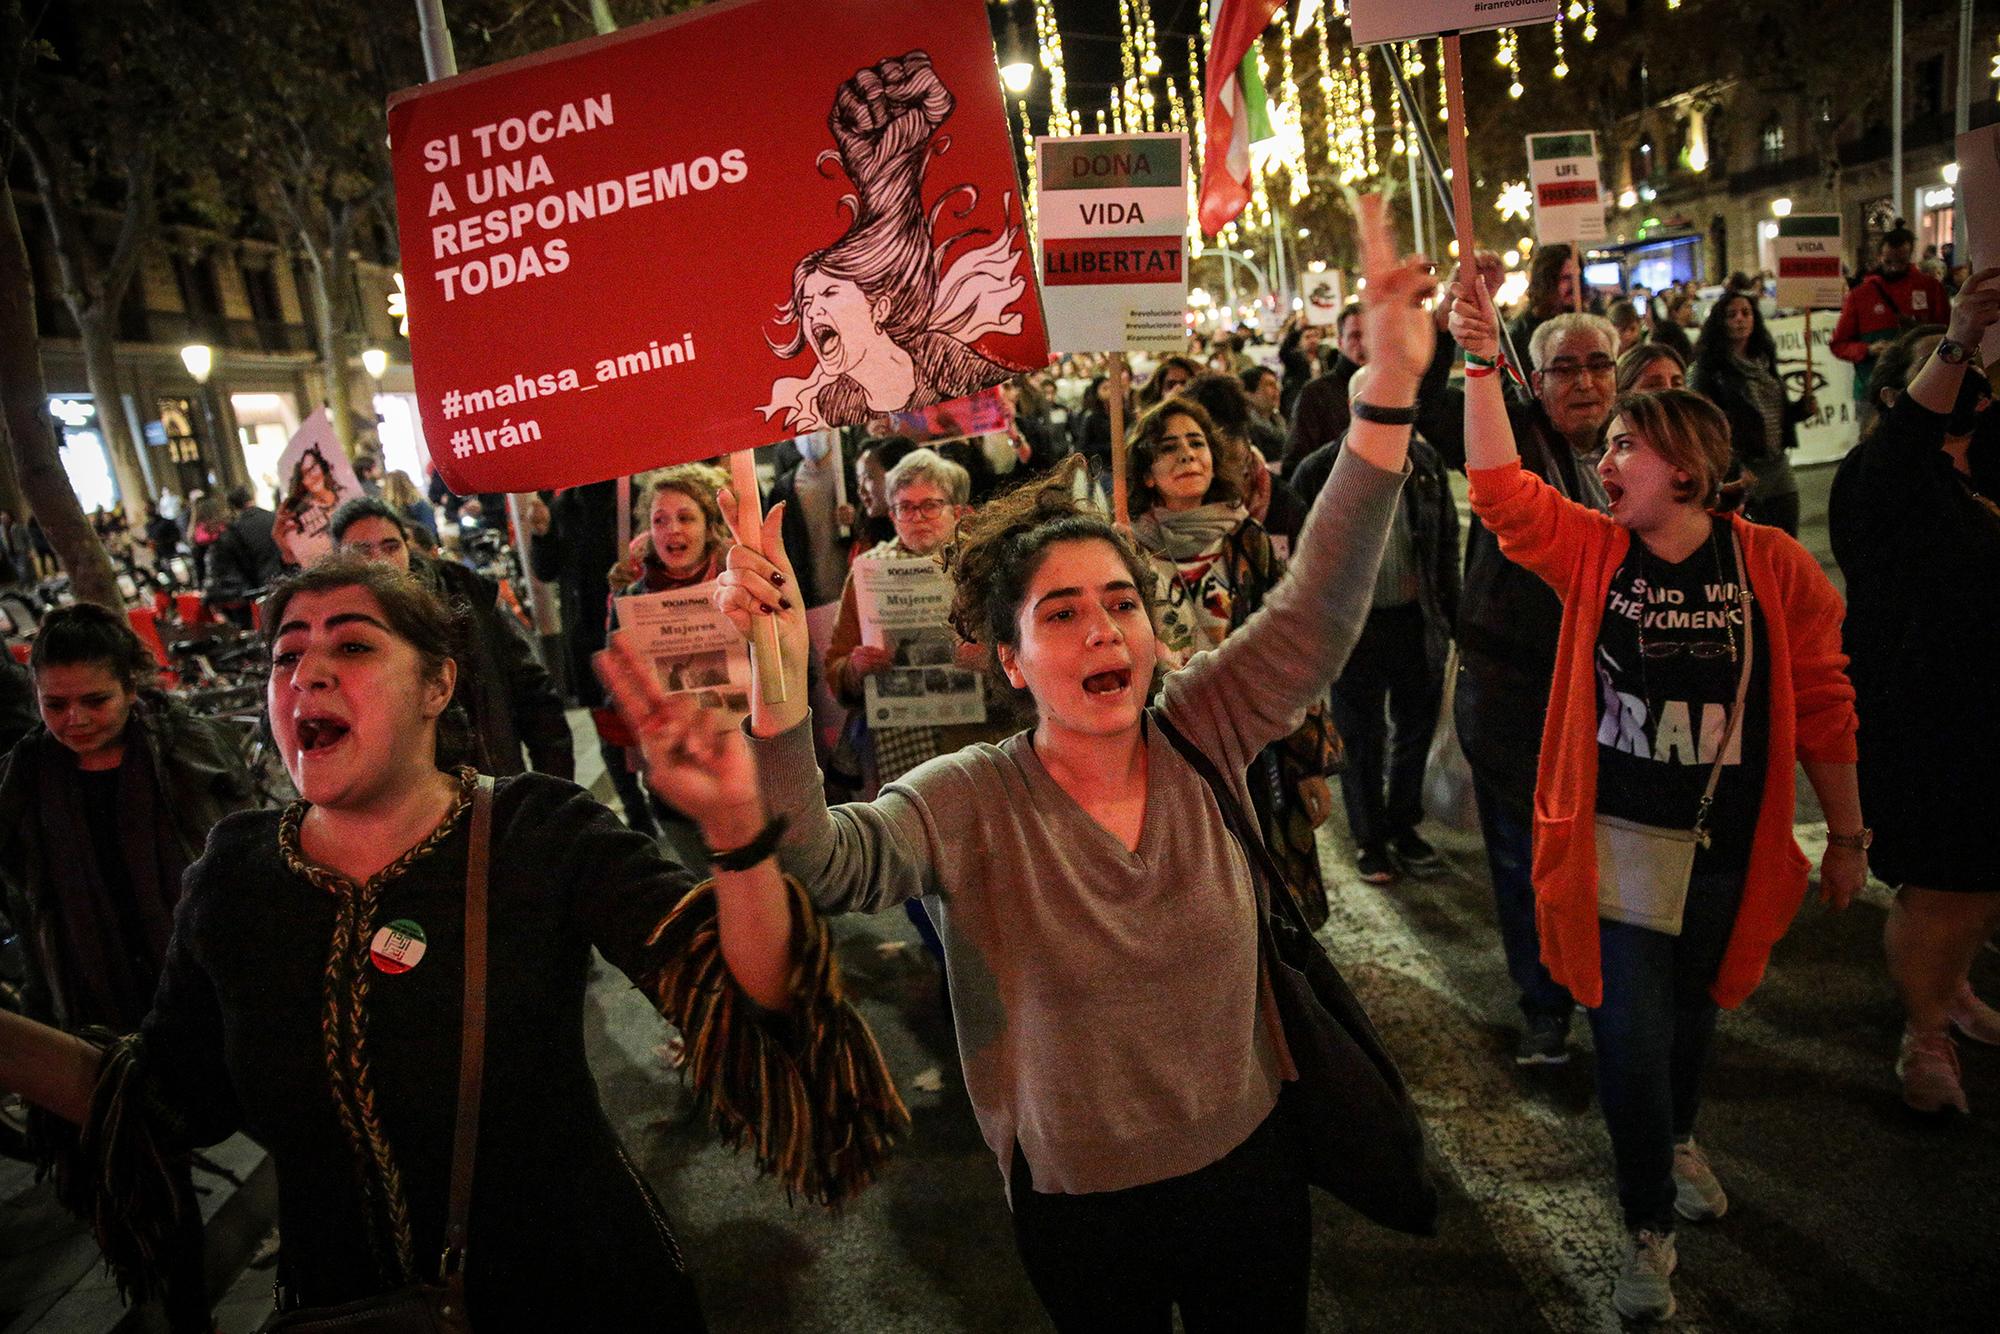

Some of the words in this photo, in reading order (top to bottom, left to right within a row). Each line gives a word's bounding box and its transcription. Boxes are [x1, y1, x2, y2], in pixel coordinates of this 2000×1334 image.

[1474, 0, 1551, 12] #iranrevolu
[423, 135, 461, 173] SI
[472, 93, 614, 158] TOCAN
[1072, 153, 1151, 178] DONA
[1555, 164, 1579, 177] LIFE
[428, 181, 456, 217] A
[466, 154, 555, 204] UNA
[432, 148, 748, 259] RESPONDEMOS
[1079, 202, 1145, 225] VIDA
[1795, 241, 1826, 252] VIDA
[435, 238, 570, 302] TODAS
[1046, 250, 1180, 274] LLIBERTAT
[441, 332, 696, 420] #mahsa_amini
[450, 418, 542, 460] #Irán
[886, 595, 943, 607] Mujeres
[660, 622, 717, 636] Mujeres
